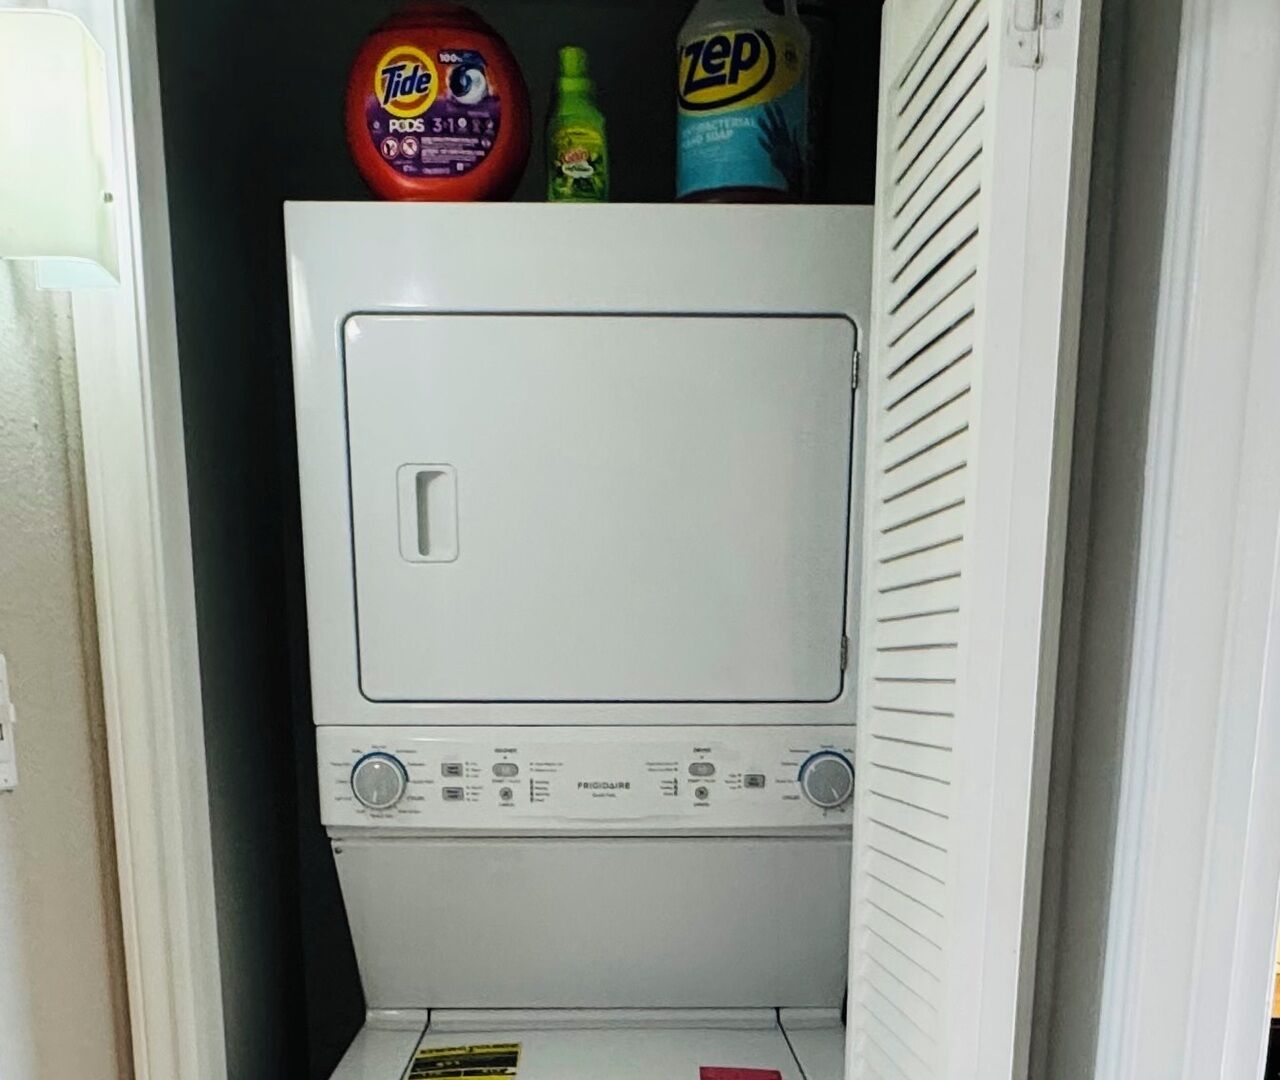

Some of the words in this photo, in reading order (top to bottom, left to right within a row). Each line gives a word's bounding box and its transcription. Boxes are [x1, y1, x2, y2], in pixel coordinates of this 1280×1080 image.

[381, 63, 432, 105] Tide
[389, 119, 425, 133] PODS
[577, 782, 631, 790] FRIGIDAIRE
